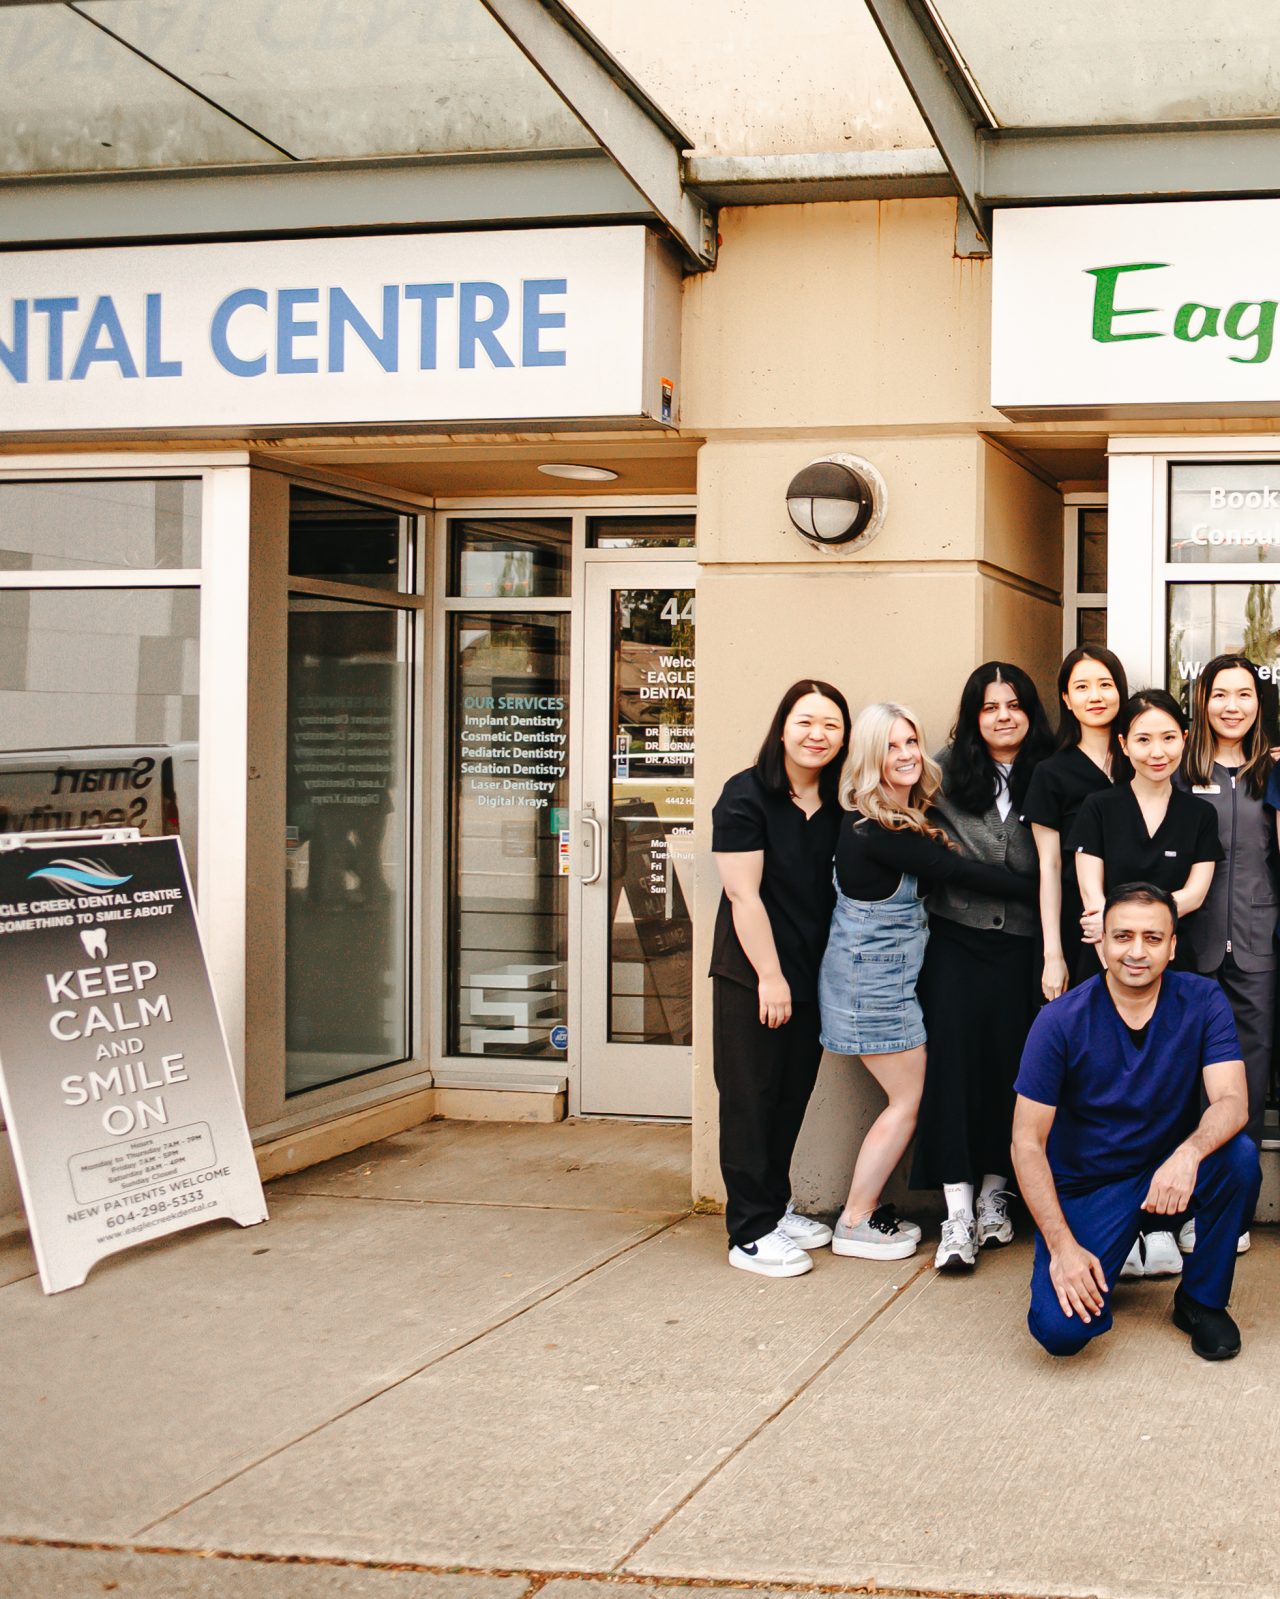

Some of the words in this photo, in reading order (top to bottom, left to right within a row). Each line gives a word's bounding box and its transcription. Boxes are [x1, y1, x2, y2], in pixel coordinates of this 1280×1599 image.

[210, 279, 568, 378] CENTRE
[1209, 485, 1279, 510] Book
[647, 671, 695, 683] EAGLE
[640, 686, 695, 699] DENTAL
[464, 696, 495, 710] OUR
[498, 696, 564, 711] SERVICES
[464, 714, 509, 728] Implant
[510, 715, 563, 729] Dentistry
[460, 730, 512, 742] Cosmetic
[513, 731, 567, 745] Dentistry
[461, 746, 511, 758] Pediatric
[513, 747, 566, 761] Dentistry
[460, 762, 511, 774] Sedation
[513, 763, 566, 777] Dentistry
[471, 779, 501, 790] Laser
[503, 779, 556, 793] Dentistry
[478, 795, 515, 808] Digital
[517, 796, 549, 809] Xrays
[650, 862, 662, 871] Fri
[650, 874, 664, 882] Sat
[650, 885, 667, 894] Sun
[30, 898, 77, 914] CREEK
[78, 894, 132, 909] DENTAL
[133, 888, 183, 903] CENTRE
[78, 912, 95, 925] TO
[96, 908, 133, 923] SMILE
[134, 904, 174, 918] ABOUT
[46, 960, 158, 1004] KEEP
[49, 994, 173, 1042] CALM
[96, 1037, 145, 1061] AND
[61, 1053, 190, 1107] SMILE
[102, 1096, 169, 1137] ON
[80, 1159, 113, 1173] Monday
[115, 1156, 125, 1164] to
[126, 1146, 161, 1161] Thursday
[163, 1140, 180, 1150] 7AM
[108, 1169, 143, 1184] Saturday
[111, 1162, 137, 1174] Friday
[121, 1177, 150, 1189] Sunday
[152, 1168, 178, 1180] Closed
[67, 1206, 100, 1224] NEW
[104, 1186, 167, 1212] PATIENTS
[169, 1166, 232, 1191] WELCOME
[106, 1189, 205, 1229] 604-298-5333
[96, 1199, 218, 1244] www.eaglecreekdental.ca
